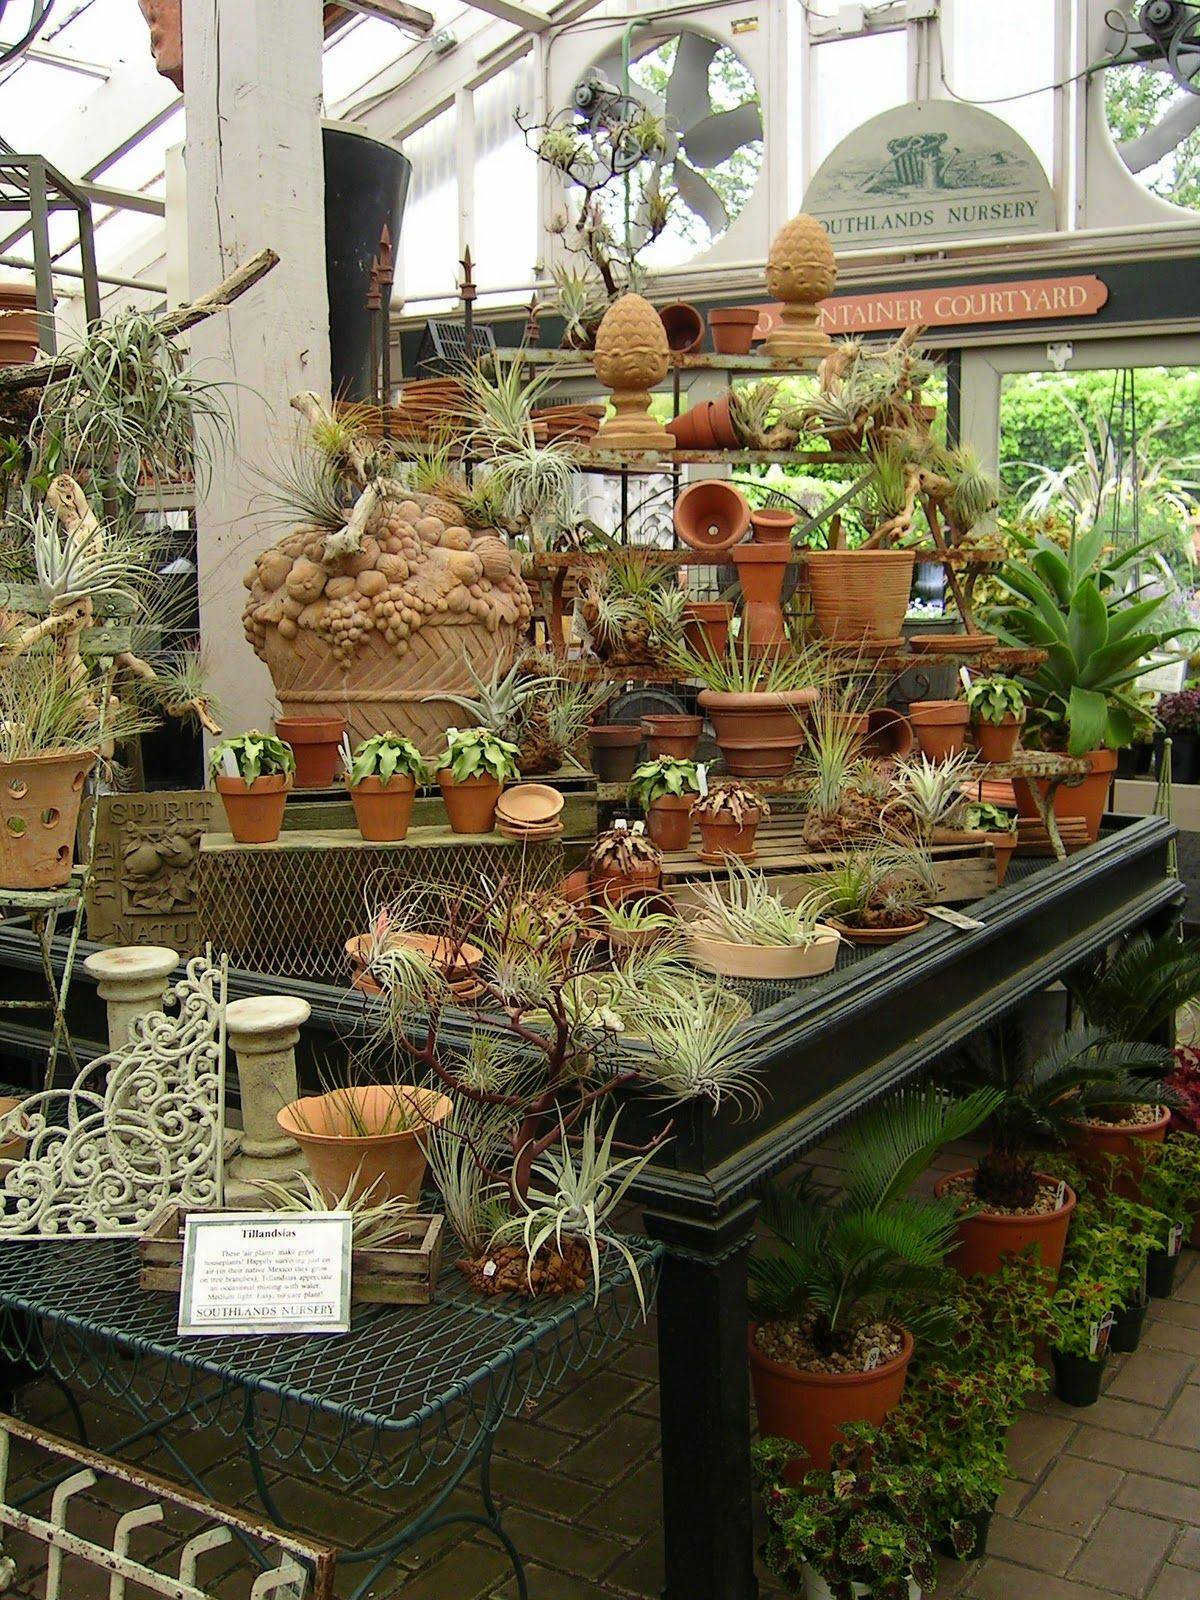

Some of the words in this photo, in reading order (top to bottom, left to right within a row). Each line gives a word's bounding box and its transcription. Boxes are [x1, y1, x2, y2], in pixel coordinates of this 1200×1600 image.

[819, 210, 934, 234] OUTHLANDS
[948, 200, 1038, 223] NURSERY
[817, 298, 923, 328] NTAINER
[934, 285, 1088, 318] COURTYARD
[110, 801, 214, 826] SPIRIT
[113, 921, 195, 944] NATU
[241, 1229, 297, 1239] Tillandsias
[267, 1265, 292, 1273] Mexico
[196, 1306, 277, 1318] SOUTHLANDS
[282, 1305, 335, 1315] NURSERY
